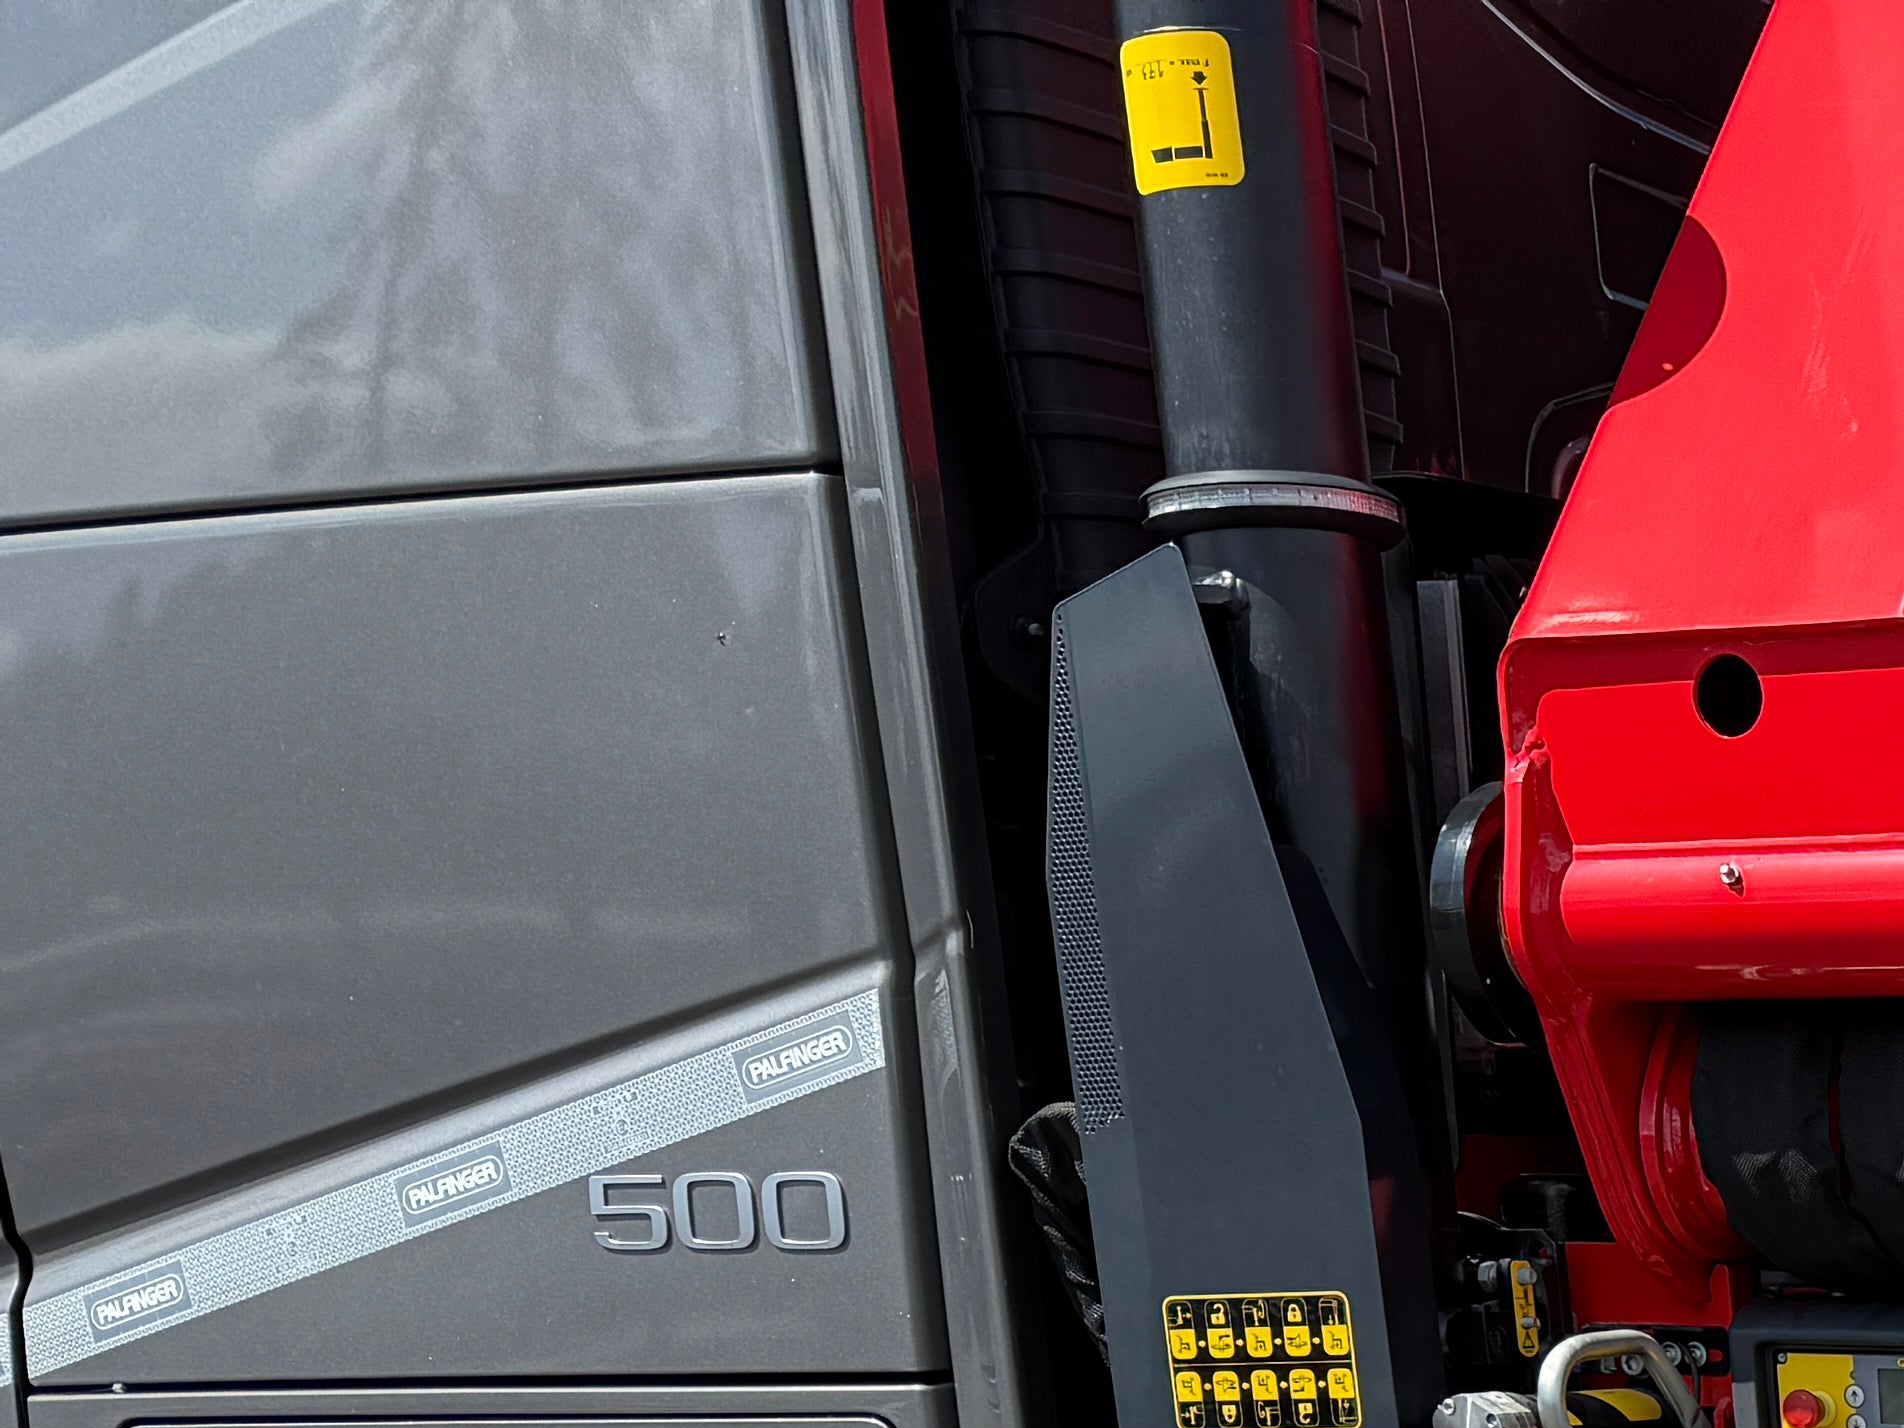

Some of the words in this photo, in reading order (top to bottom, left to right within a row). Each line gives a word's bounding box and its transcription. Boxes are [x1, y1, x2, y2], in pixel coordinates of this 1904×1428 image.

[749, 1031, 847, 1083] PALFINGER
[407, 1157, 501, 1211] PALFINGER
[588, 1171, 848, 1253] 500
[95, 1278, 179, 1326] PALFINGER
